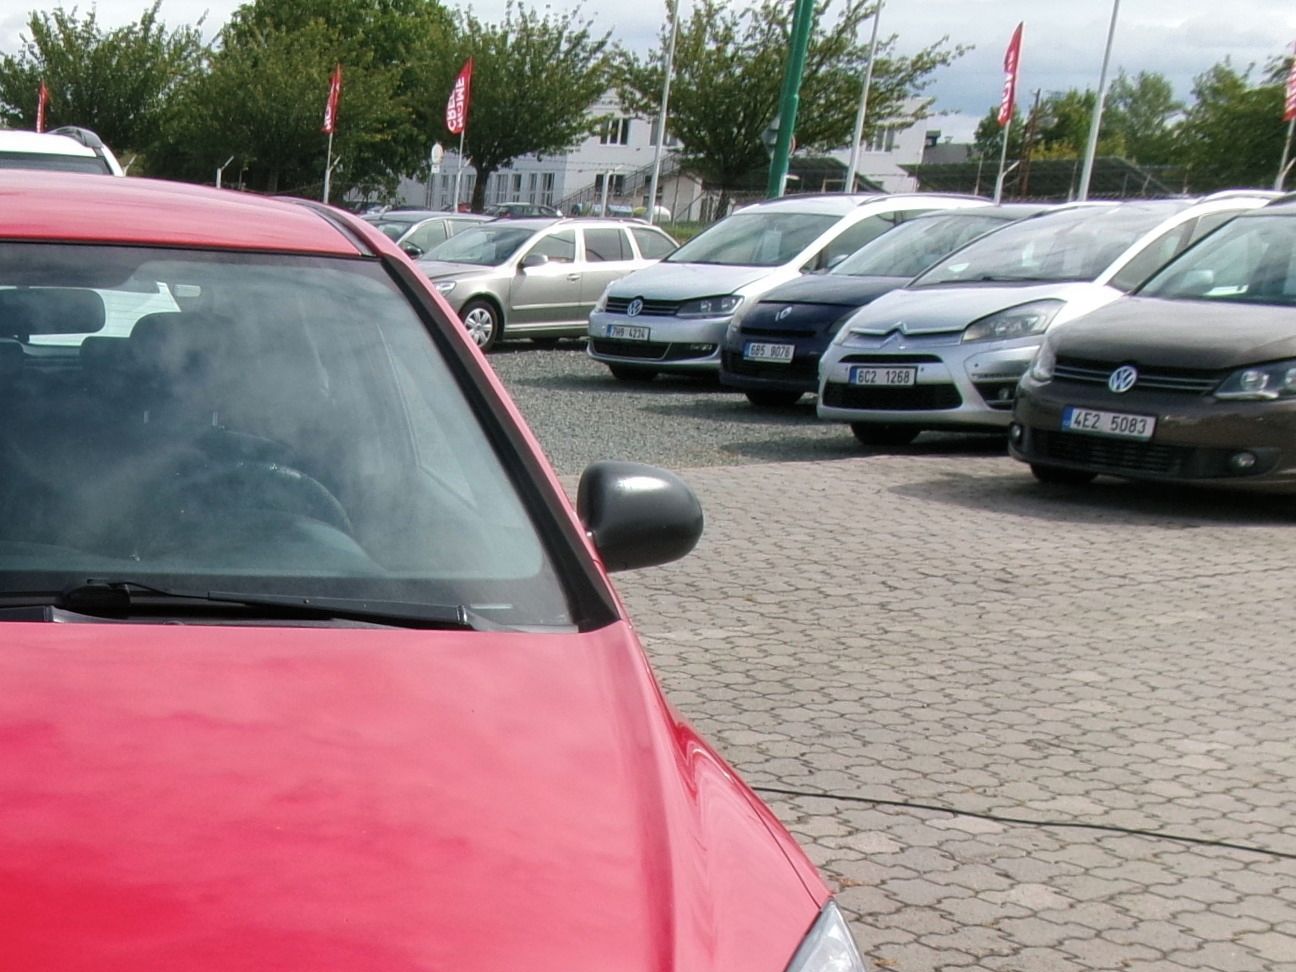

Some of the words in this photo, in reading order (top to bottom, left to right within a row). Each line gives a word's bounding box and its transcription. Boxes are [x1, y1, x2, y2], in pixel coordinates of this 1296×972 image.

[857, 369, 877, 384] 6C2
[885, 370, 910, 384] 1268
[1073, 411, 1101, 430] 4E2
[1109, 415, 1147, 434] 5083
